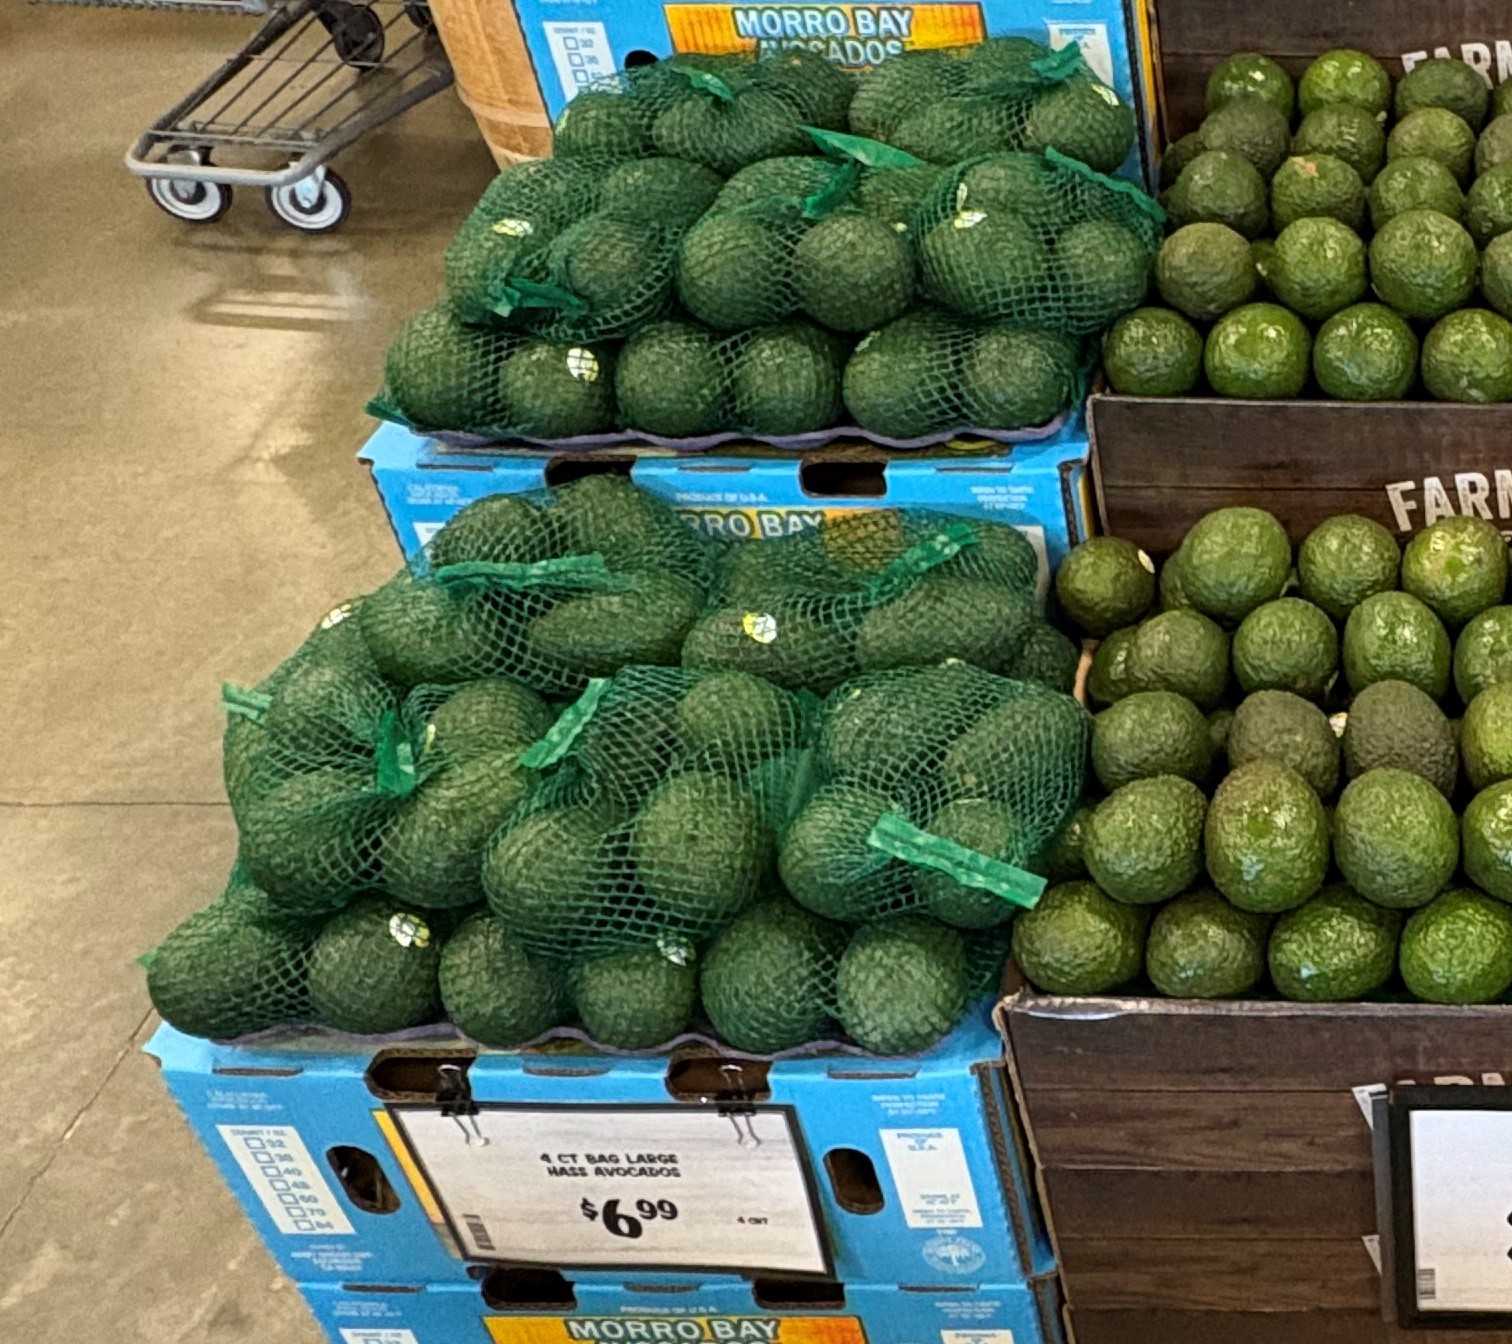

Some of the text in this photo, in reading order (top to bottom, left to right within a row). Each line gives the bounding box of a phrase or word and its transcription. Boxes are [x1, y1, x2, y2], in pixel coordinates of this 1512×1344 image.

[733, 8, 913, 38] MORRO BAY
[759, 38, 905, 67] CADOS
[760, 513, 823, 538] BAY
[557, 1154, 578, 1165] CT
[584, 1153, 621, 1165] BAG
[626, 1154, 679, 1166] LARGE
[547, 1166, 681, 1178] HASS AVOCADOS
[568, 1319, 779, 1341] MORRO BAY
